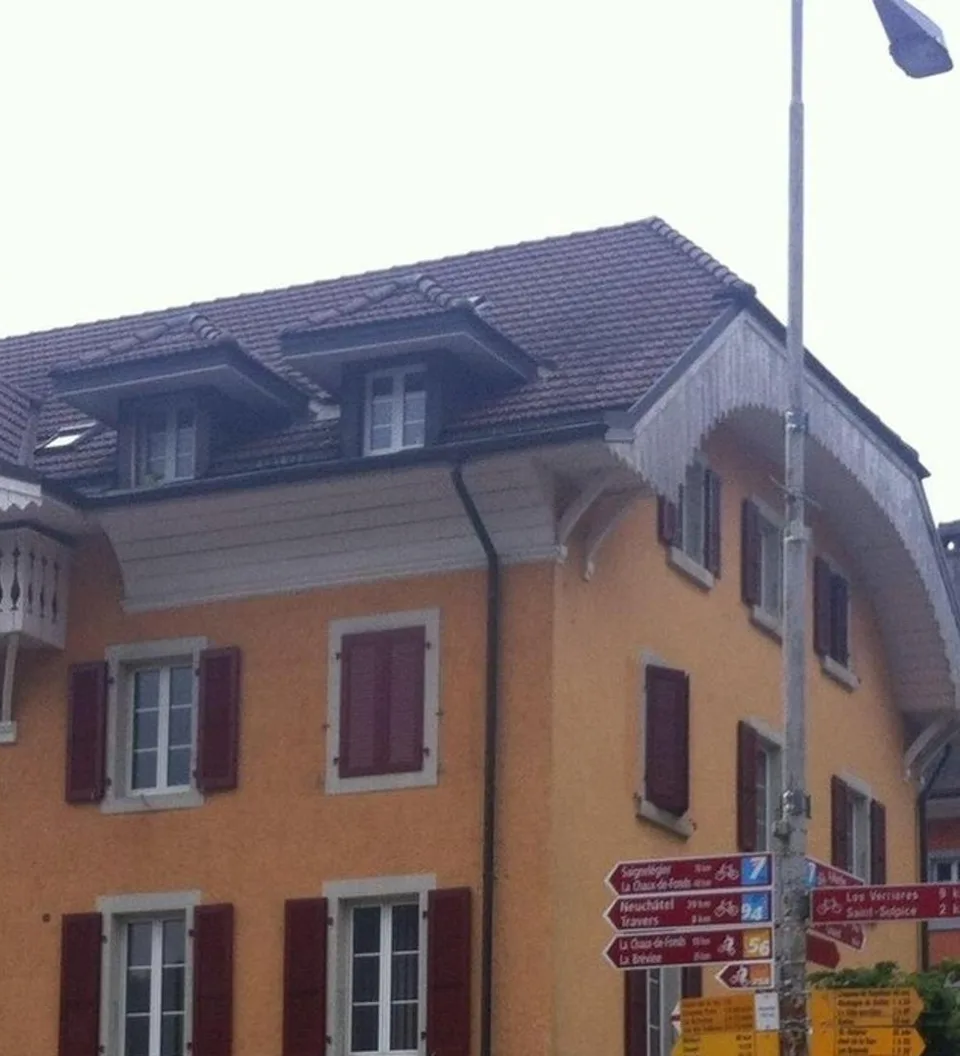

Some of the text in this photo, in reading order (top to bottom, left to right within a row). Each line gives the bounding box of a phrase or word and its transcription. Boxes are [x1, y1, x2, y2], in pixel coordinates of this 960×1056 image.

[749, 856, 767, 880] 7
[621, 882, 631, 892] La
[620, 899, 675, 913] Neuchâtel
[741, 903, 763, 922] 94
[939, 904, 948, 915] 2
[620, 916, 659, 928] Travers
[748, 937, 771, 957] 56
